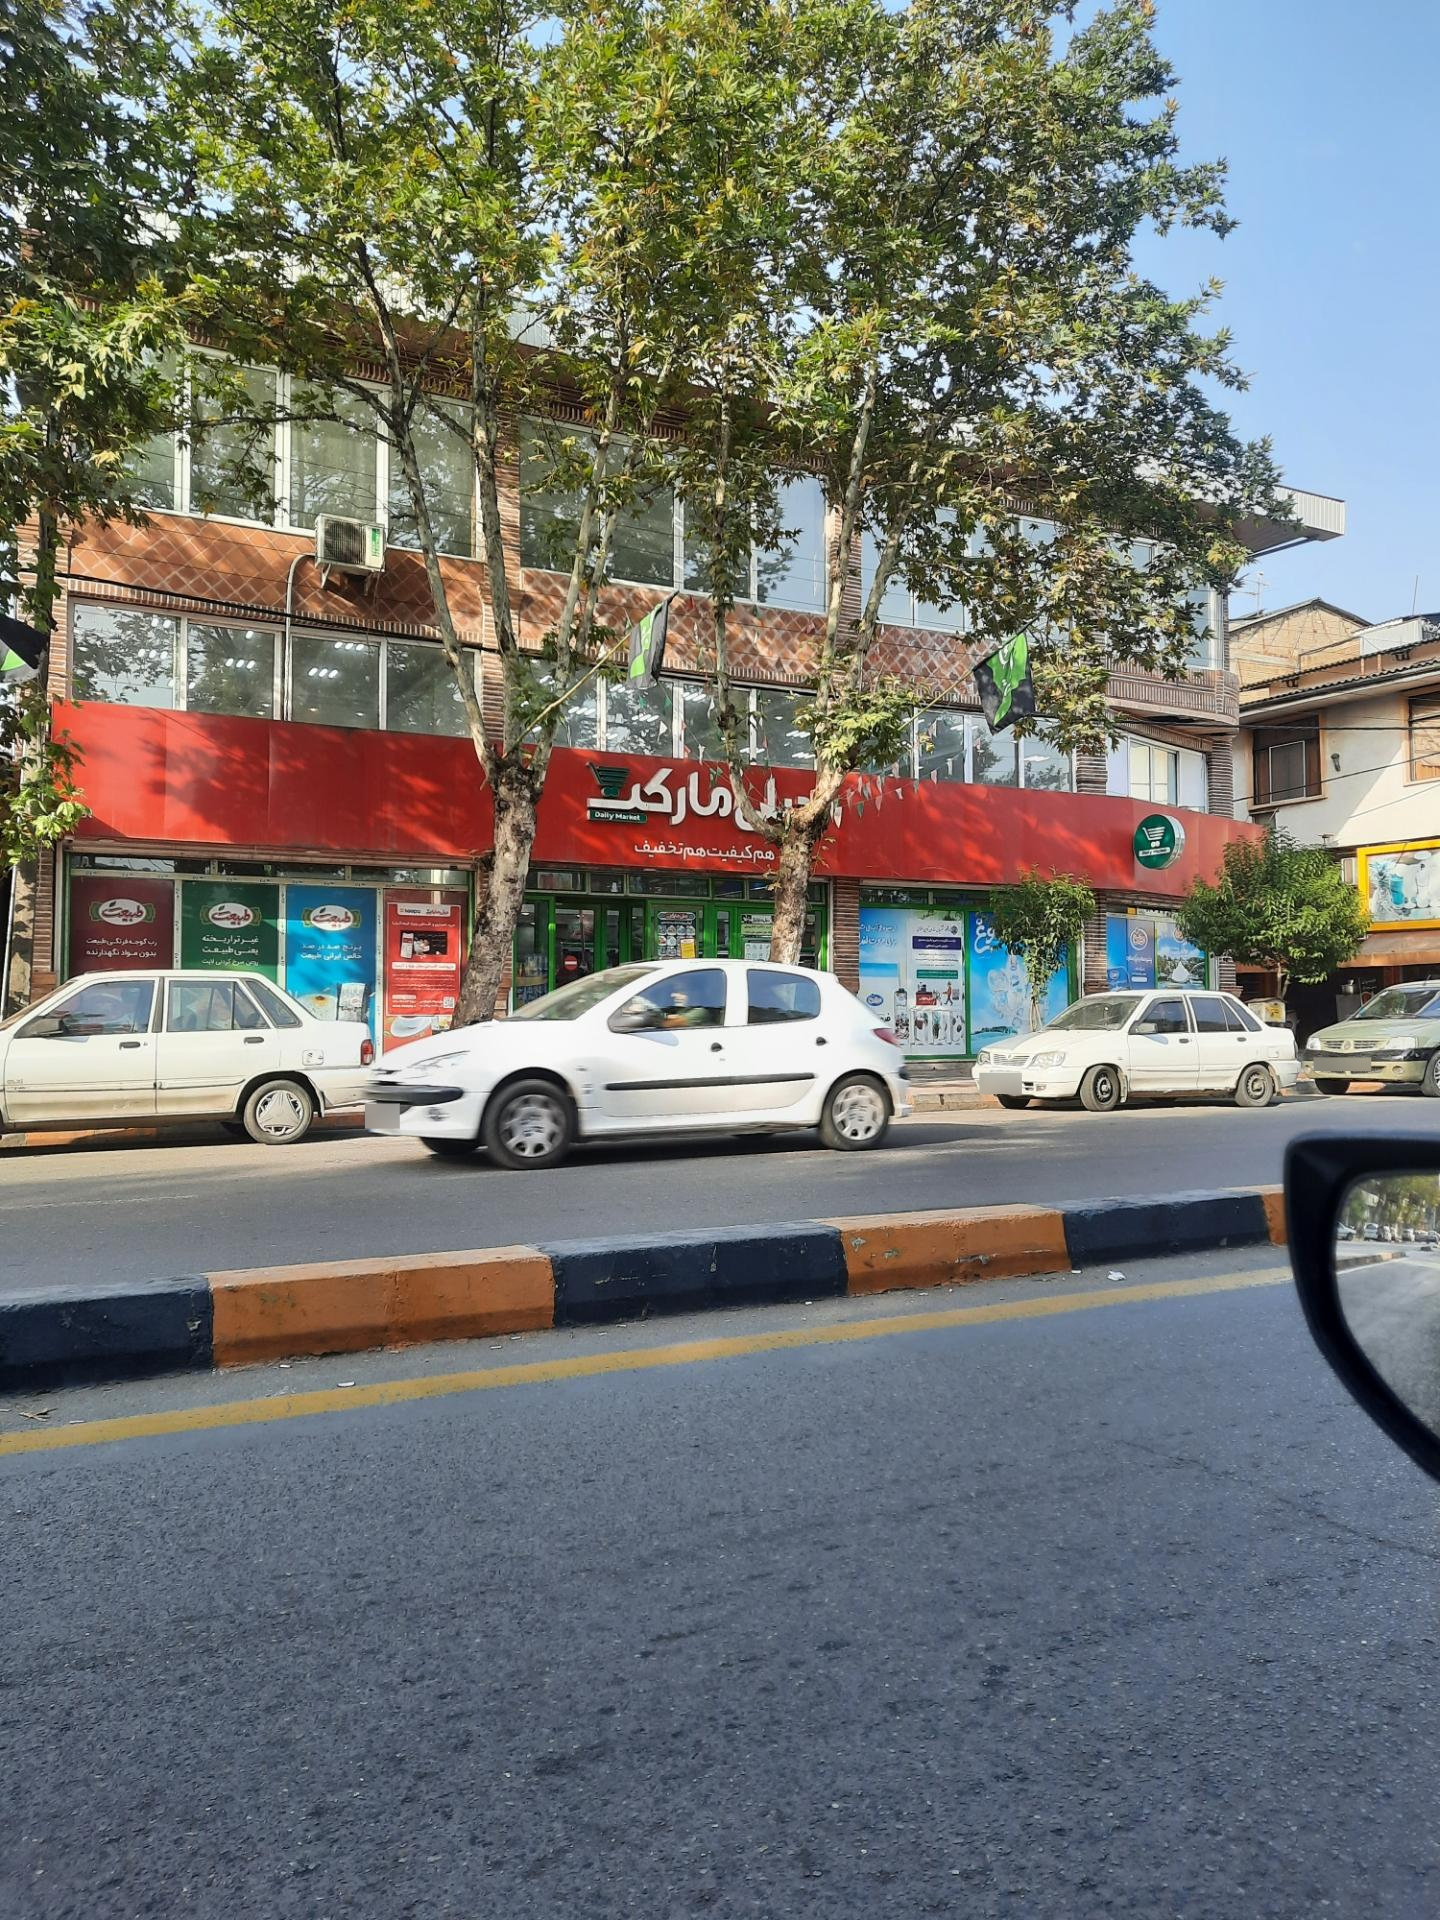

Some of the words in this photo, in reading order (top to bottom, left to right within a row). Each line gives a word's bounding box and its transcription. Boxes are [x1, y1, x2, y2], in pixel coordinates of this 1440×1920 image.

[587, 768, 733, 825] مارکت
[594, 811, 614, 821] Daily
[615, 813, 641, 821] Market
[634, 840, 684, 858] تخفیف
[683, 845, 707, 861] هم
[707, 845, 753, 864] کیفیت
[753, 850, 775, 864] هم
[102, 901, 144, 922] طبیعت
[212, 905, 252, 925] طبیعت
[312, 907, 352, 927] طبیعت
